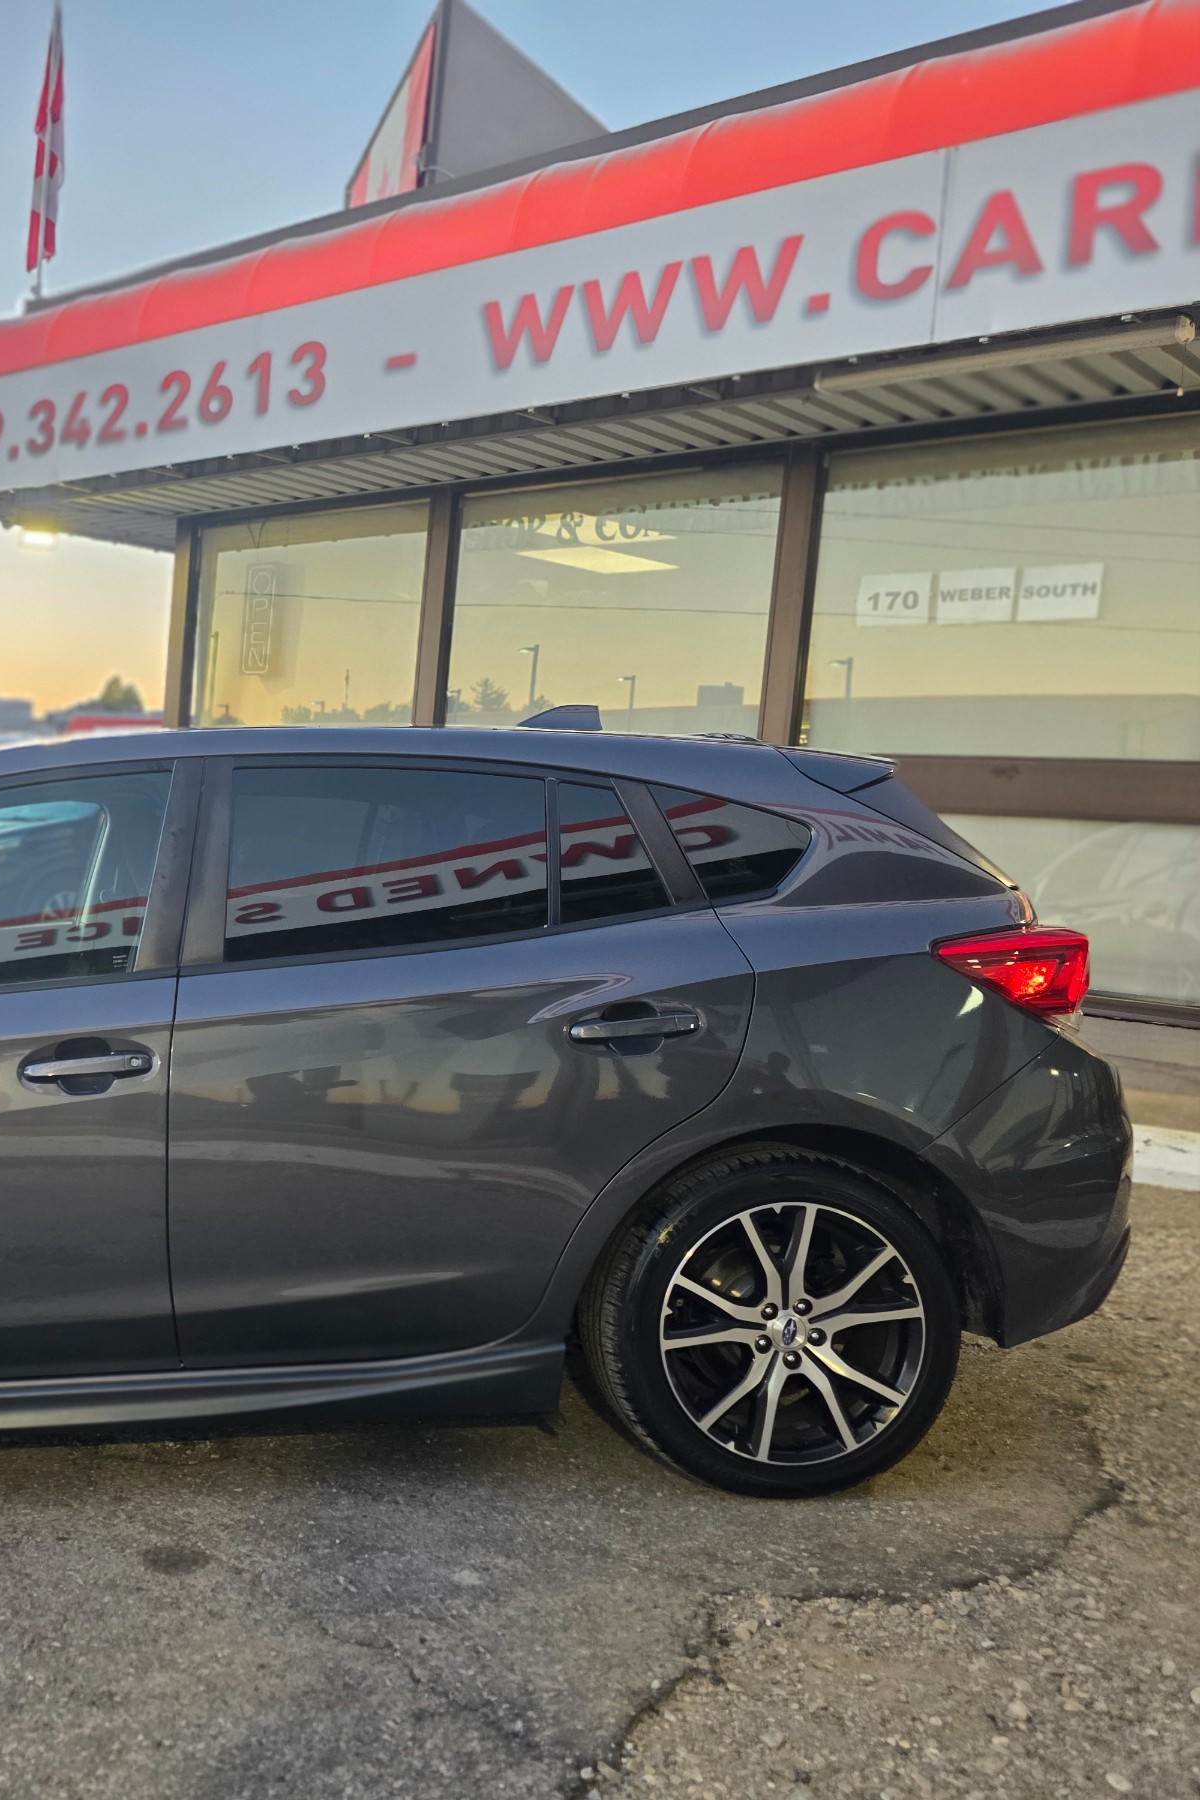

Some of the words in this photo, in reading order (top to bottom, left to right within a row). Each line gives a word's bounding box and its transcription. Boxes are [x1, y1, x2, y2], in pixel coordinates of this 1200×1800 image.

[483, 163, 1200, 374] WWW.CAR
[247, 571, 271, 668] OPEN
[867, 590, 919, 612] 170
[940, 586, 1012, 603] WEBER
[1022, 581, 1097, 600] SOUTH
